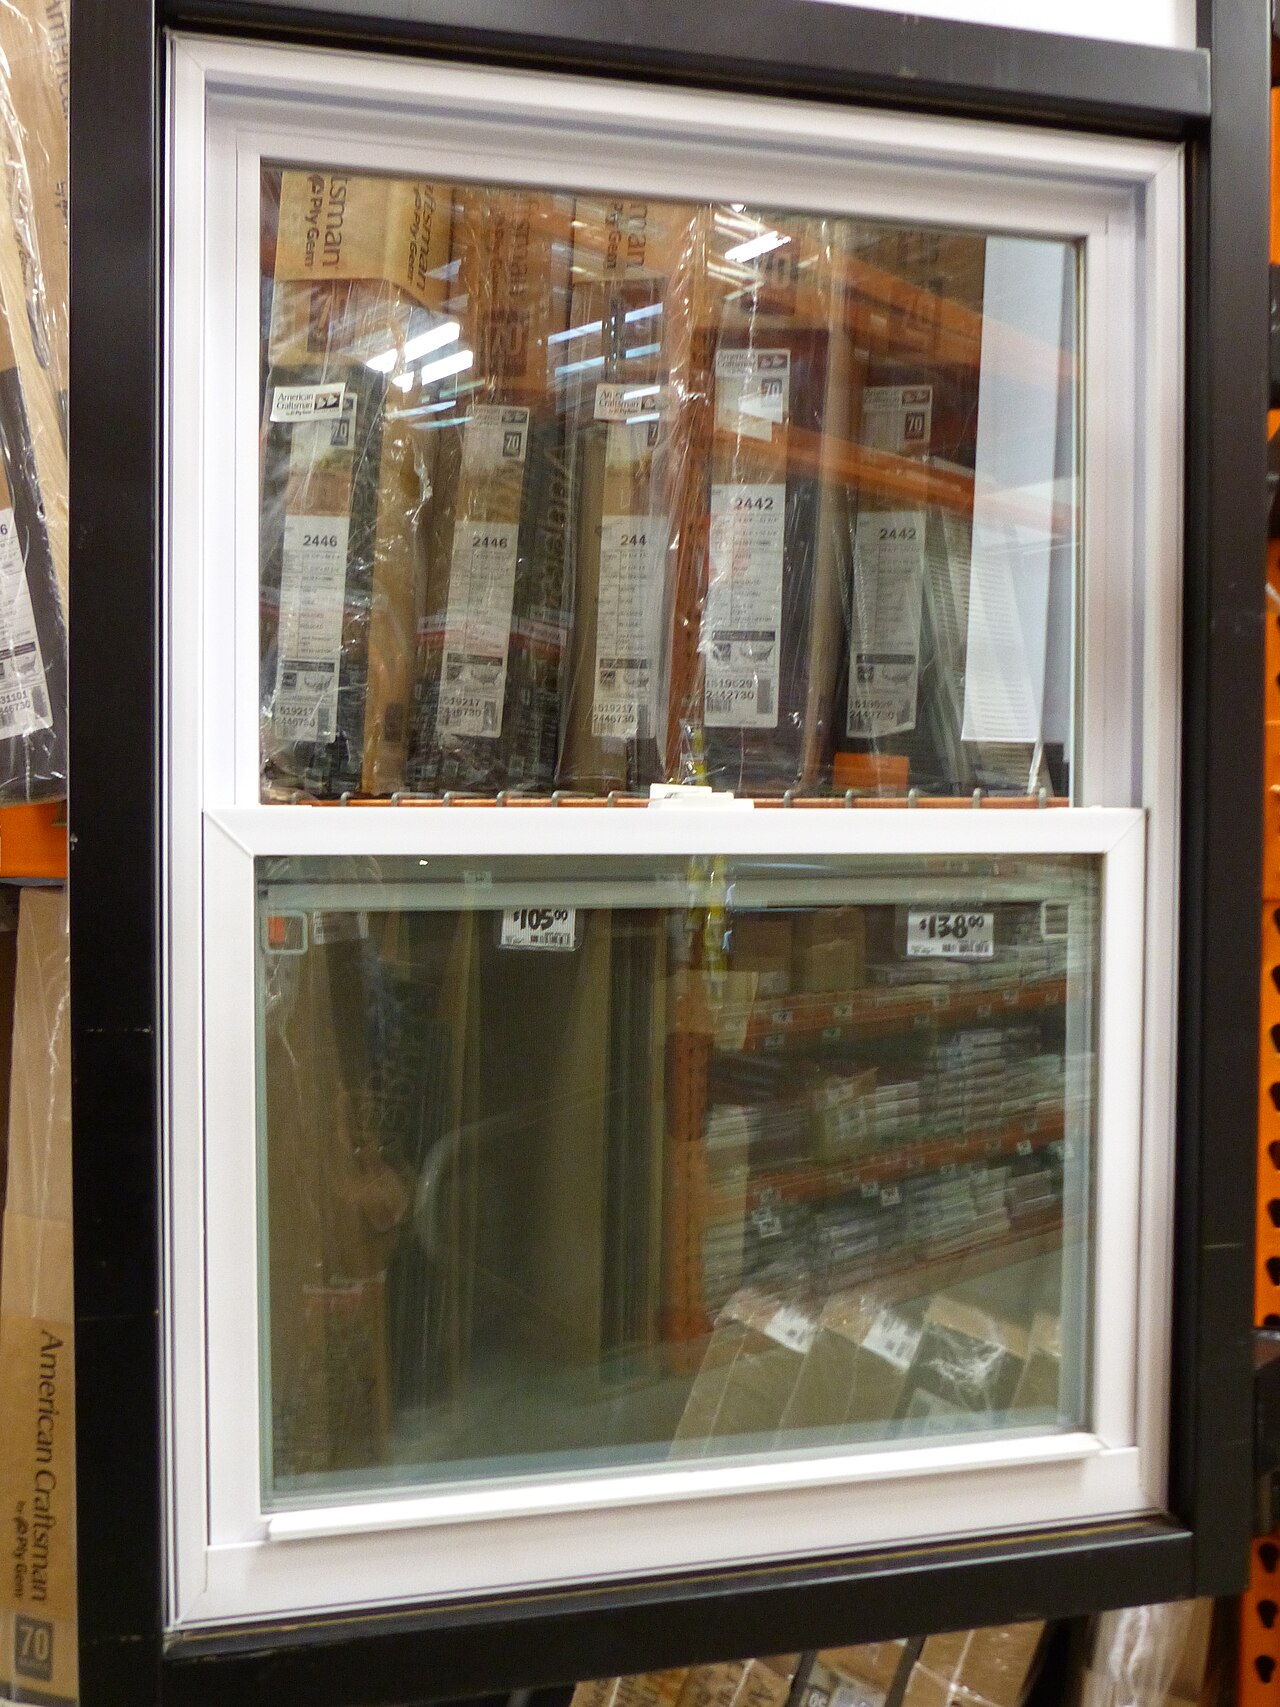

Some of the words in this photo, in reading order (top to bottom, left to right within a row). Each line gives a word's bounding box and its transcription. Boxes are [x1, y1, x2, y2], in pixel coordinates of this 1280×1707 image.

[505, 435, 520, 450] 70
[734, 497, 774, 511] 2442
[302, 534, 338, 548] 2446
[472, 536, 508, 549] 2446
[879, 527, 917, 541] 2442
[36, 1329, 65, 1464] American
[31, 1469, 58, 1602] Craftsman
[12, 1536, 28, 1559] Ply
[13, 1564, 27, 1599] Gem
[19, 1627, 50, 1661] 70
